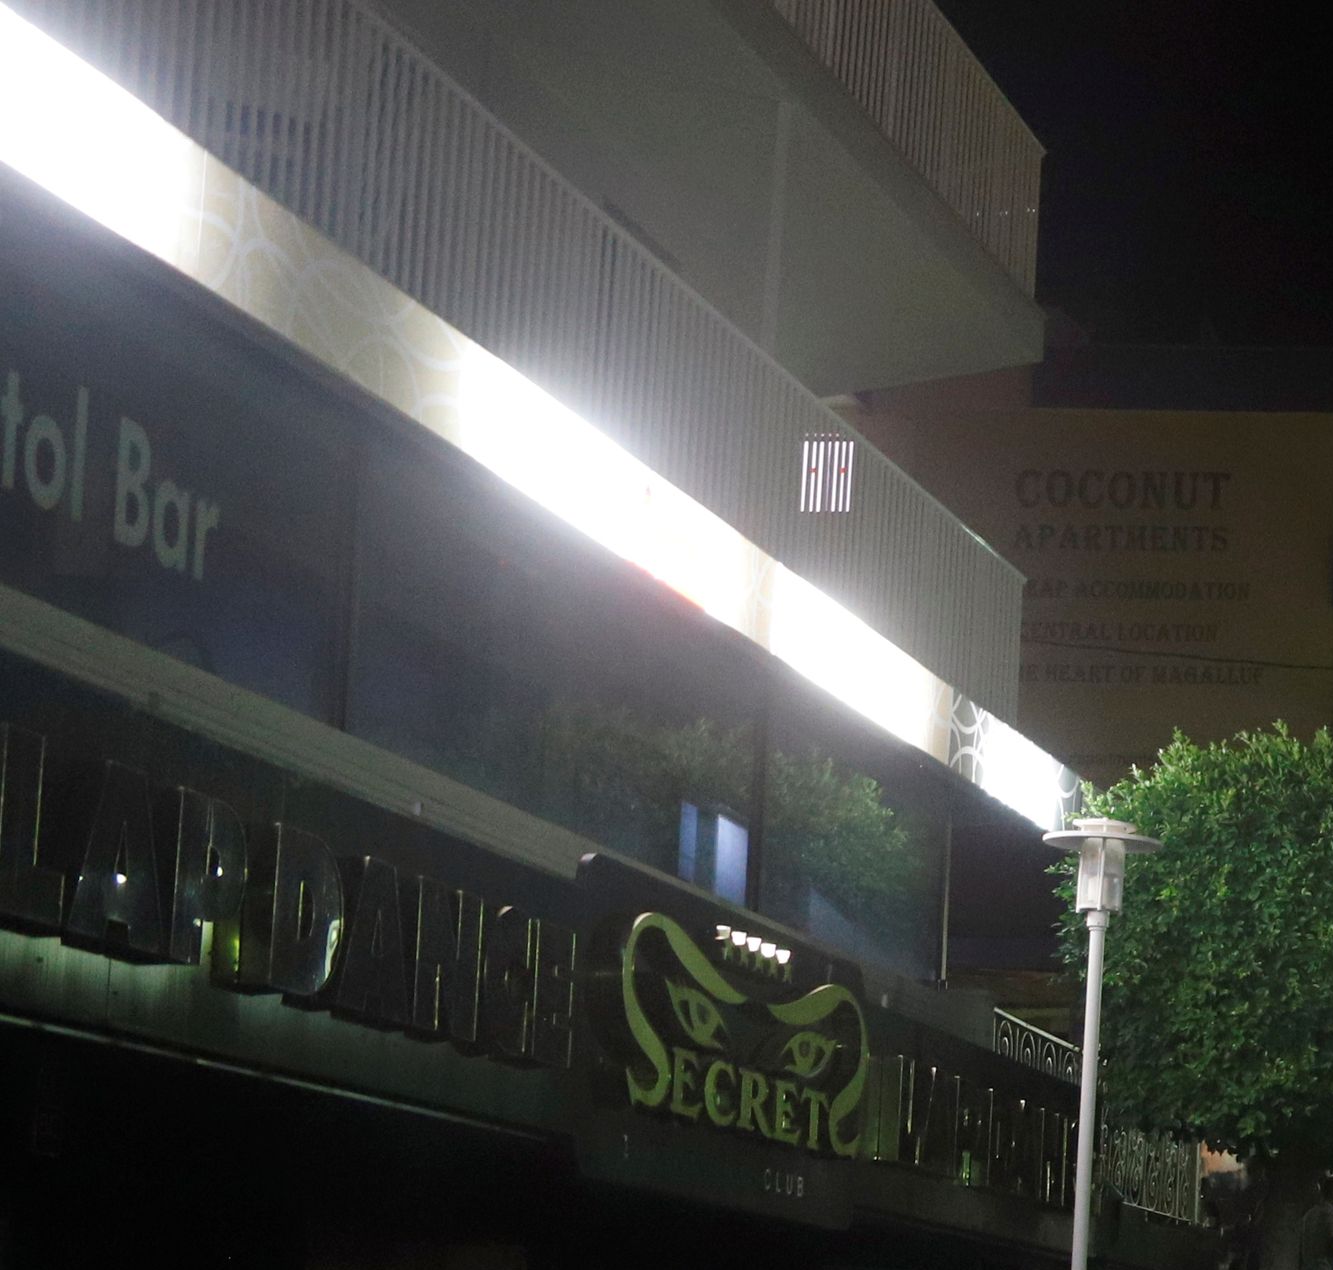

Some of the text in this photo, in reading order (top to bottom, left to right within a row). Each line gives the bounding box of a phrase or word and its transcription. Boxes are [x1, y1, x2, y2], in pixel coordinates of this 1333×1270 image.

[113, 414, 221, 581] Bar
[1014, 468, 1232, 512] COCONUT
[1013, 524, 1229, 553] APARTMENTS
[1074, 578, 1252, 602] ACCOMMODATION
[1117, 622, 1219, 644] LOCATION
[763, 1168, 804, 1197] CLUB
